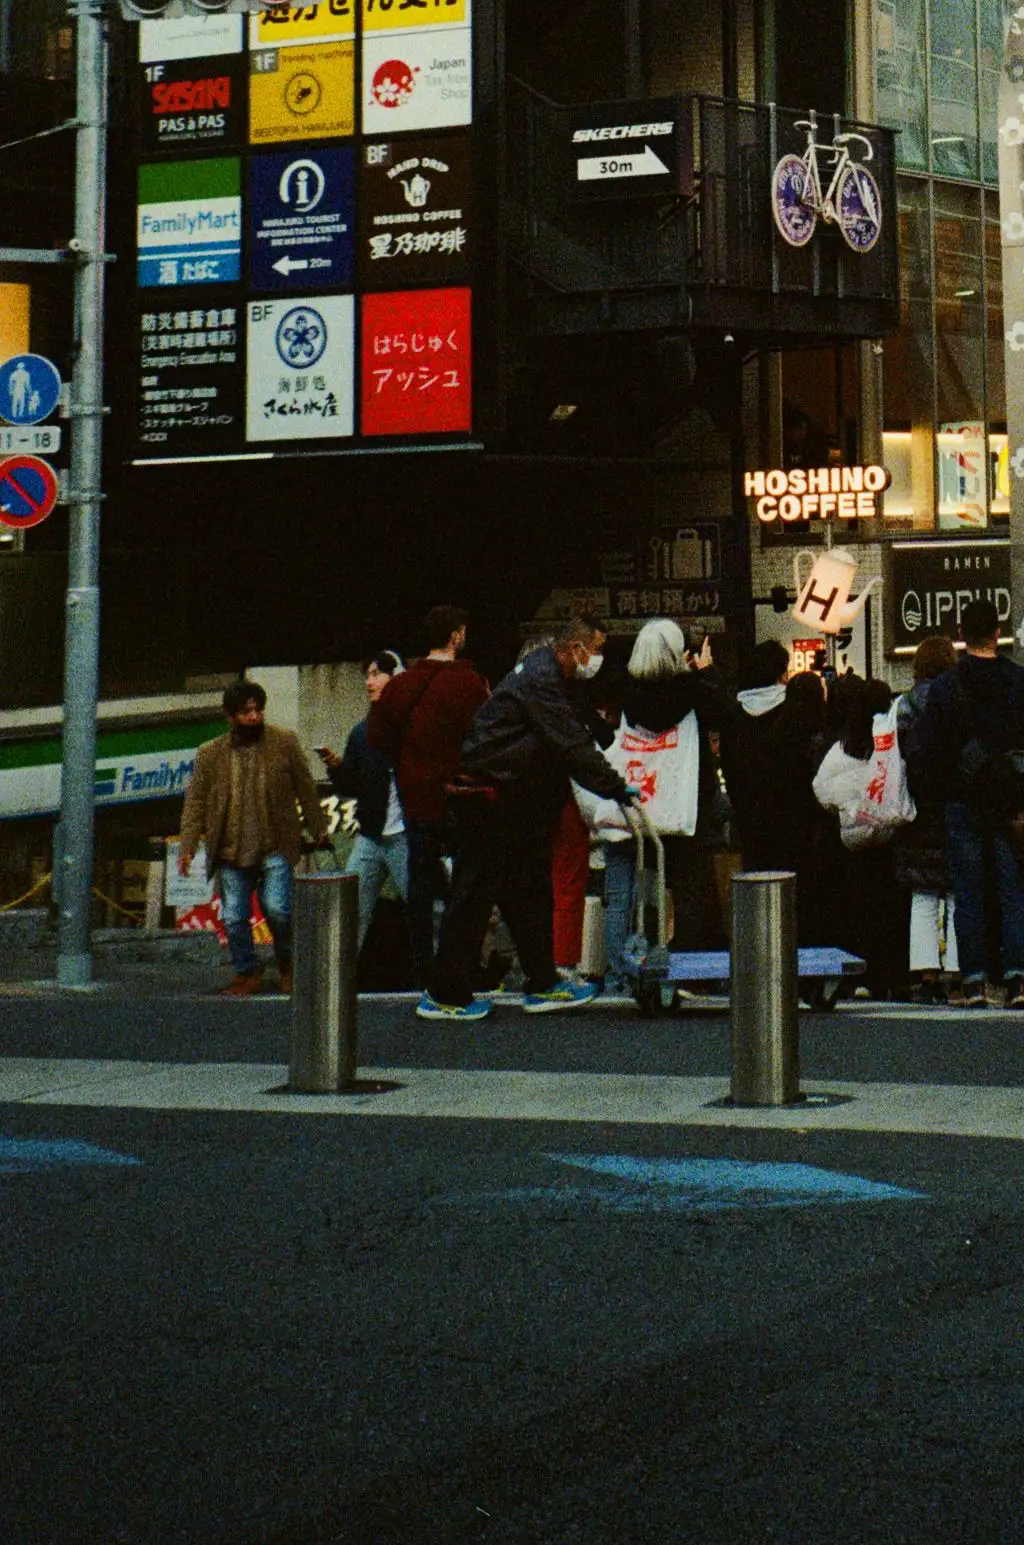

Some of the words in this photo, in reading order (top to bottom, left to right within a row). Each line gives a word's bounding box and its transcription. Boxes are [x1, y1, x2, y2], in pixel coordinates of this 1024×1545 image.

[253, 53, 275, 71] 1F
[429, 58, 466, 70] Japan
[144, 66, 164, 83] 1F
[158, 118, 185, 132] PAS
[198, 114, 225, 129] PAS
[571, 121, 675, 143] SKECHERS
[366, 145, 388, 164] BF
[599, 161, 633, 174] 30m
[141, 210, 238, 235] FamilyMart
[369, 226, 467, 259] 星乃珈琲
[252, 305, 273, 321] BF
[374, 330, 458, 354] はらじゅく
[373, 367, 460, 393] アッシュ
[744, 465, 887, 498] HOSHINO
[756, 492, 876, 522] COFFEE
[944, 556, 990, 571] RAMEN
[122, 759, 195, 792] FamilyM
